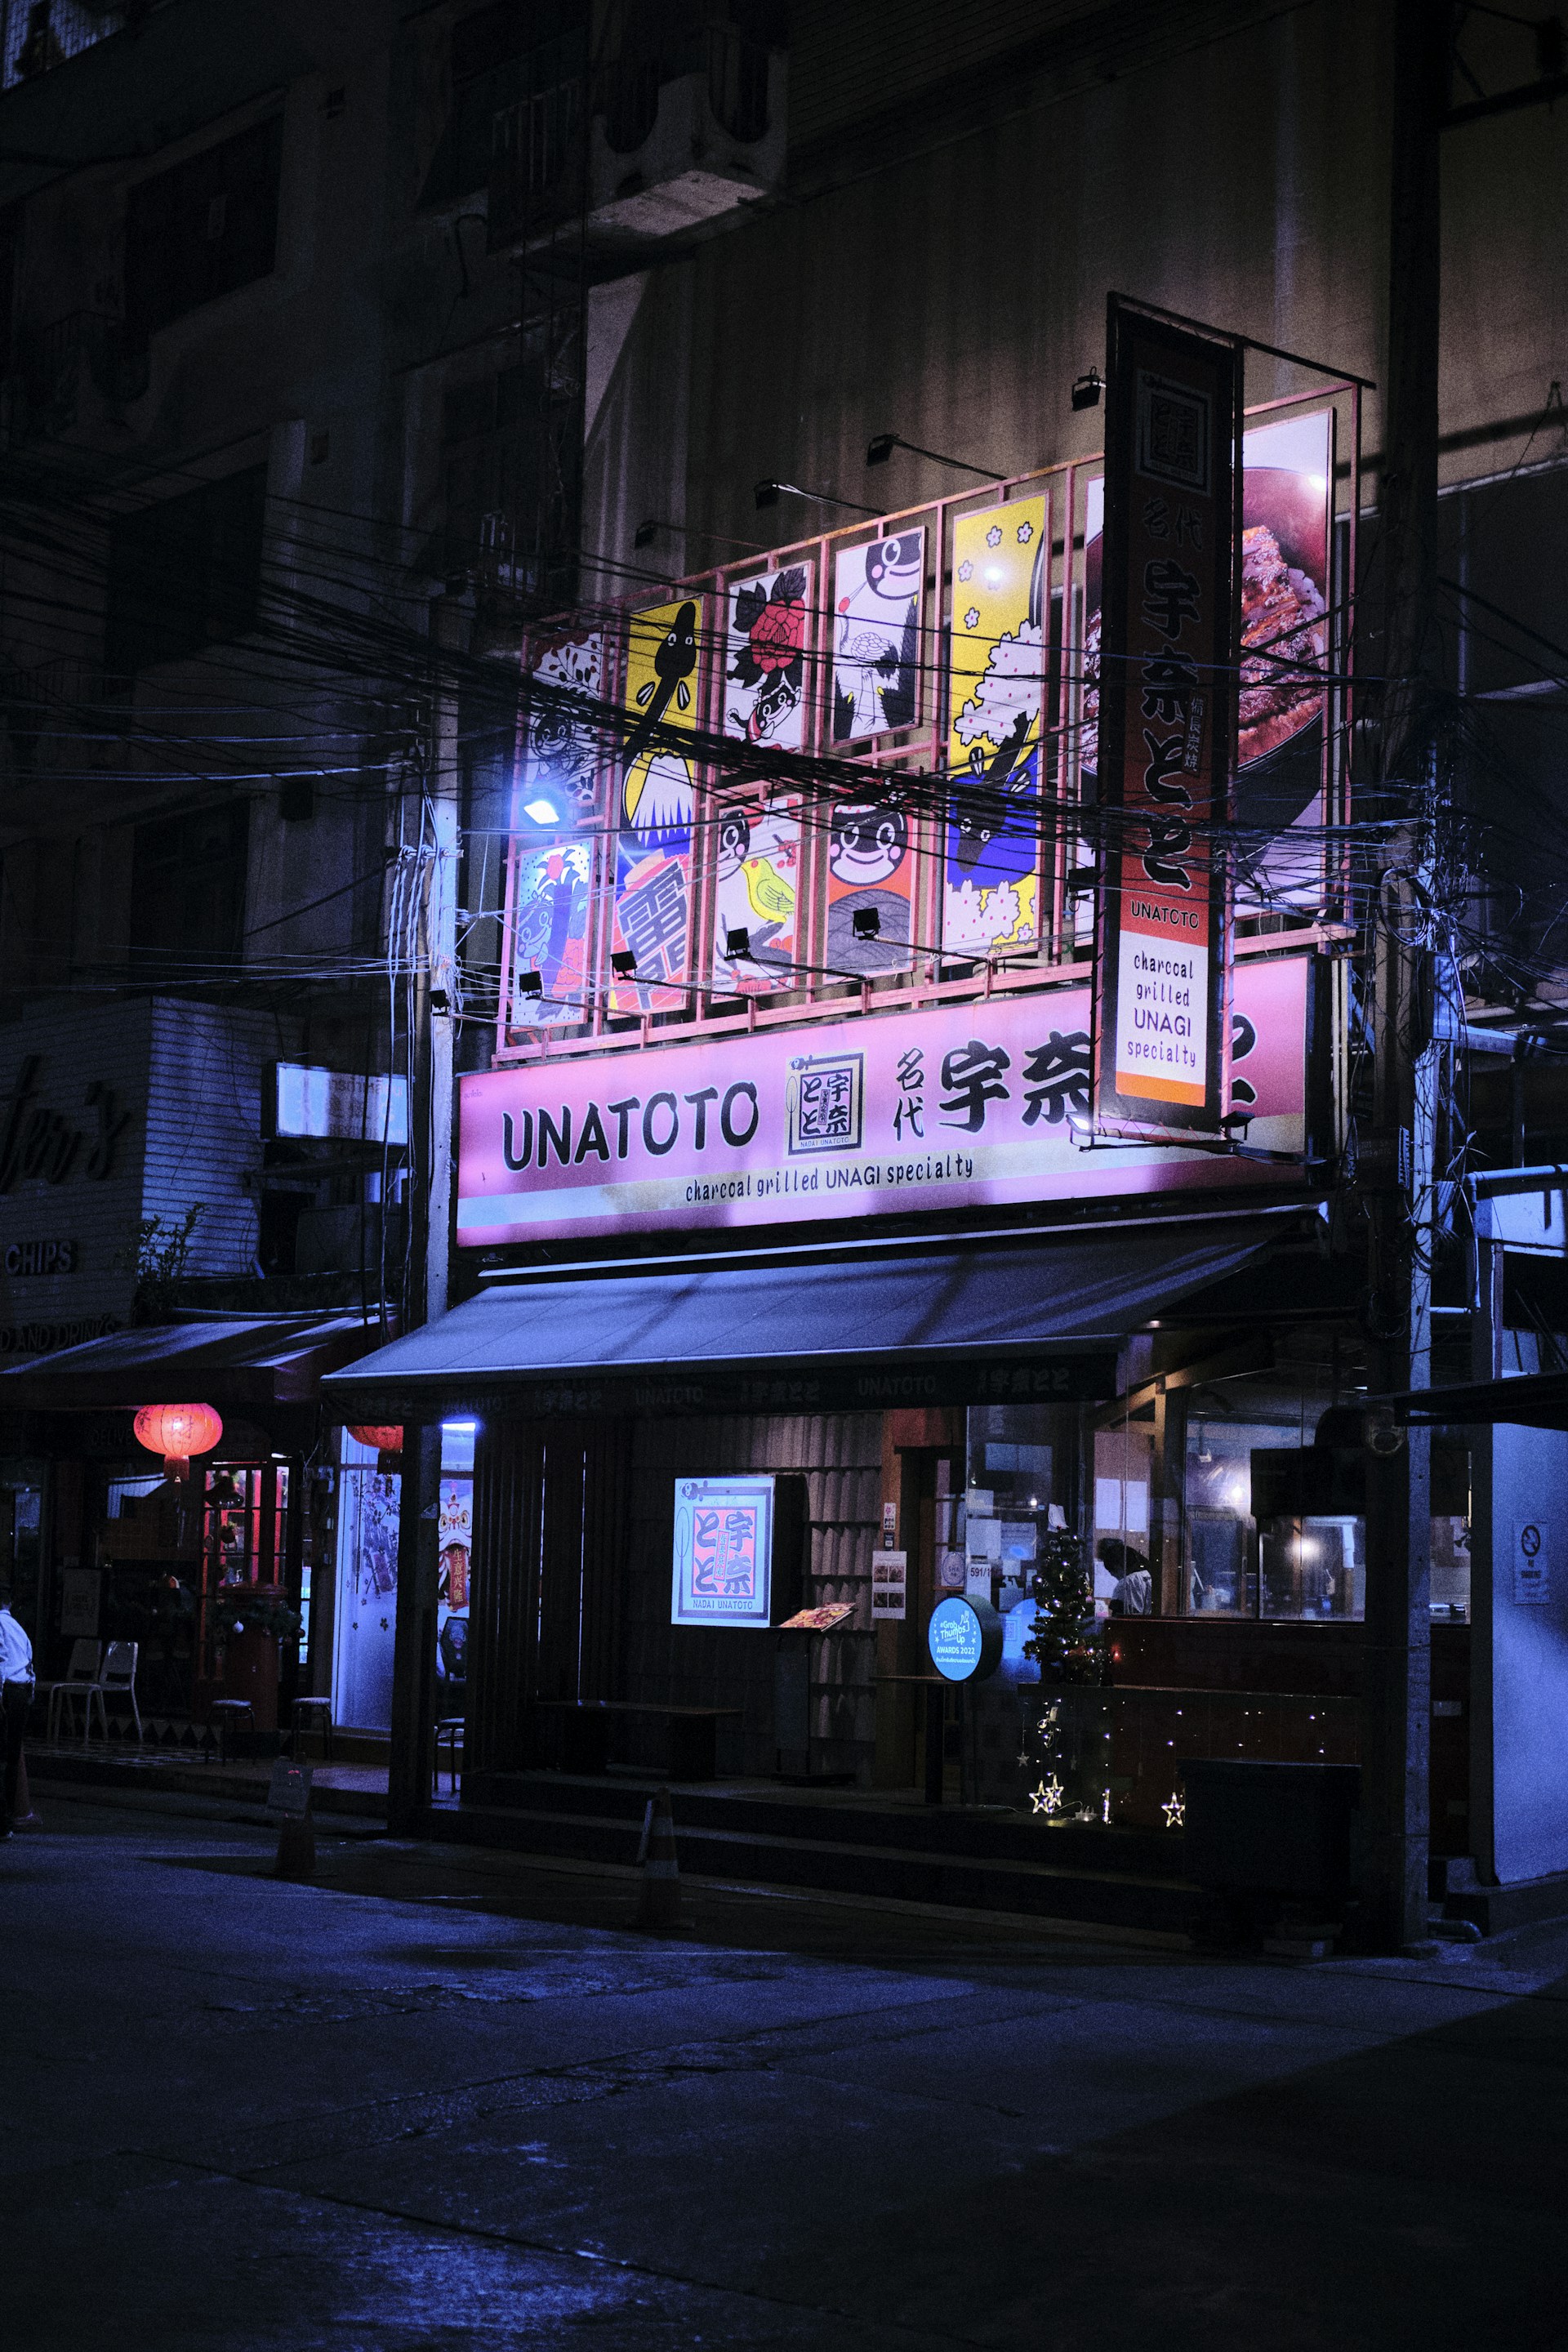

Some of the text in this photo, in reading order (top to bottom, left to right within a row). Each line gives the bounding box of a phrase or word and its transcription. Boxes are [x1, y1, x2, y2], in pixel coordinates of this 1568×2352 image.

[1130, 900, 1200, 930] UNATOTO
[1134, 950, 1194, 980] charcoal
[1136, 982, 1191, 1008] grilled
[1134, 1008, 1192, 1038] UNAGI
[1127, 1039, 1197, 1067] specialty
[893, 1047, 925, 1143] 名代
[501, 1081, 759, 1171] UNATOTO
[820, 1136, 849, 1146] UNATOTO
[686, 1155, 973, 1200] charcoal grilled UNAGI specialty
[5, 1240, 76, 1276] CHIPS
[858, 1375, 936, 1396] UNATOTO
[693, 1599, 753, 1610] NADAI UNATOTO
[940, 1624, 966, 1639] Thumbs
[937, 1646, 975, 1655] AWARDS 2022
